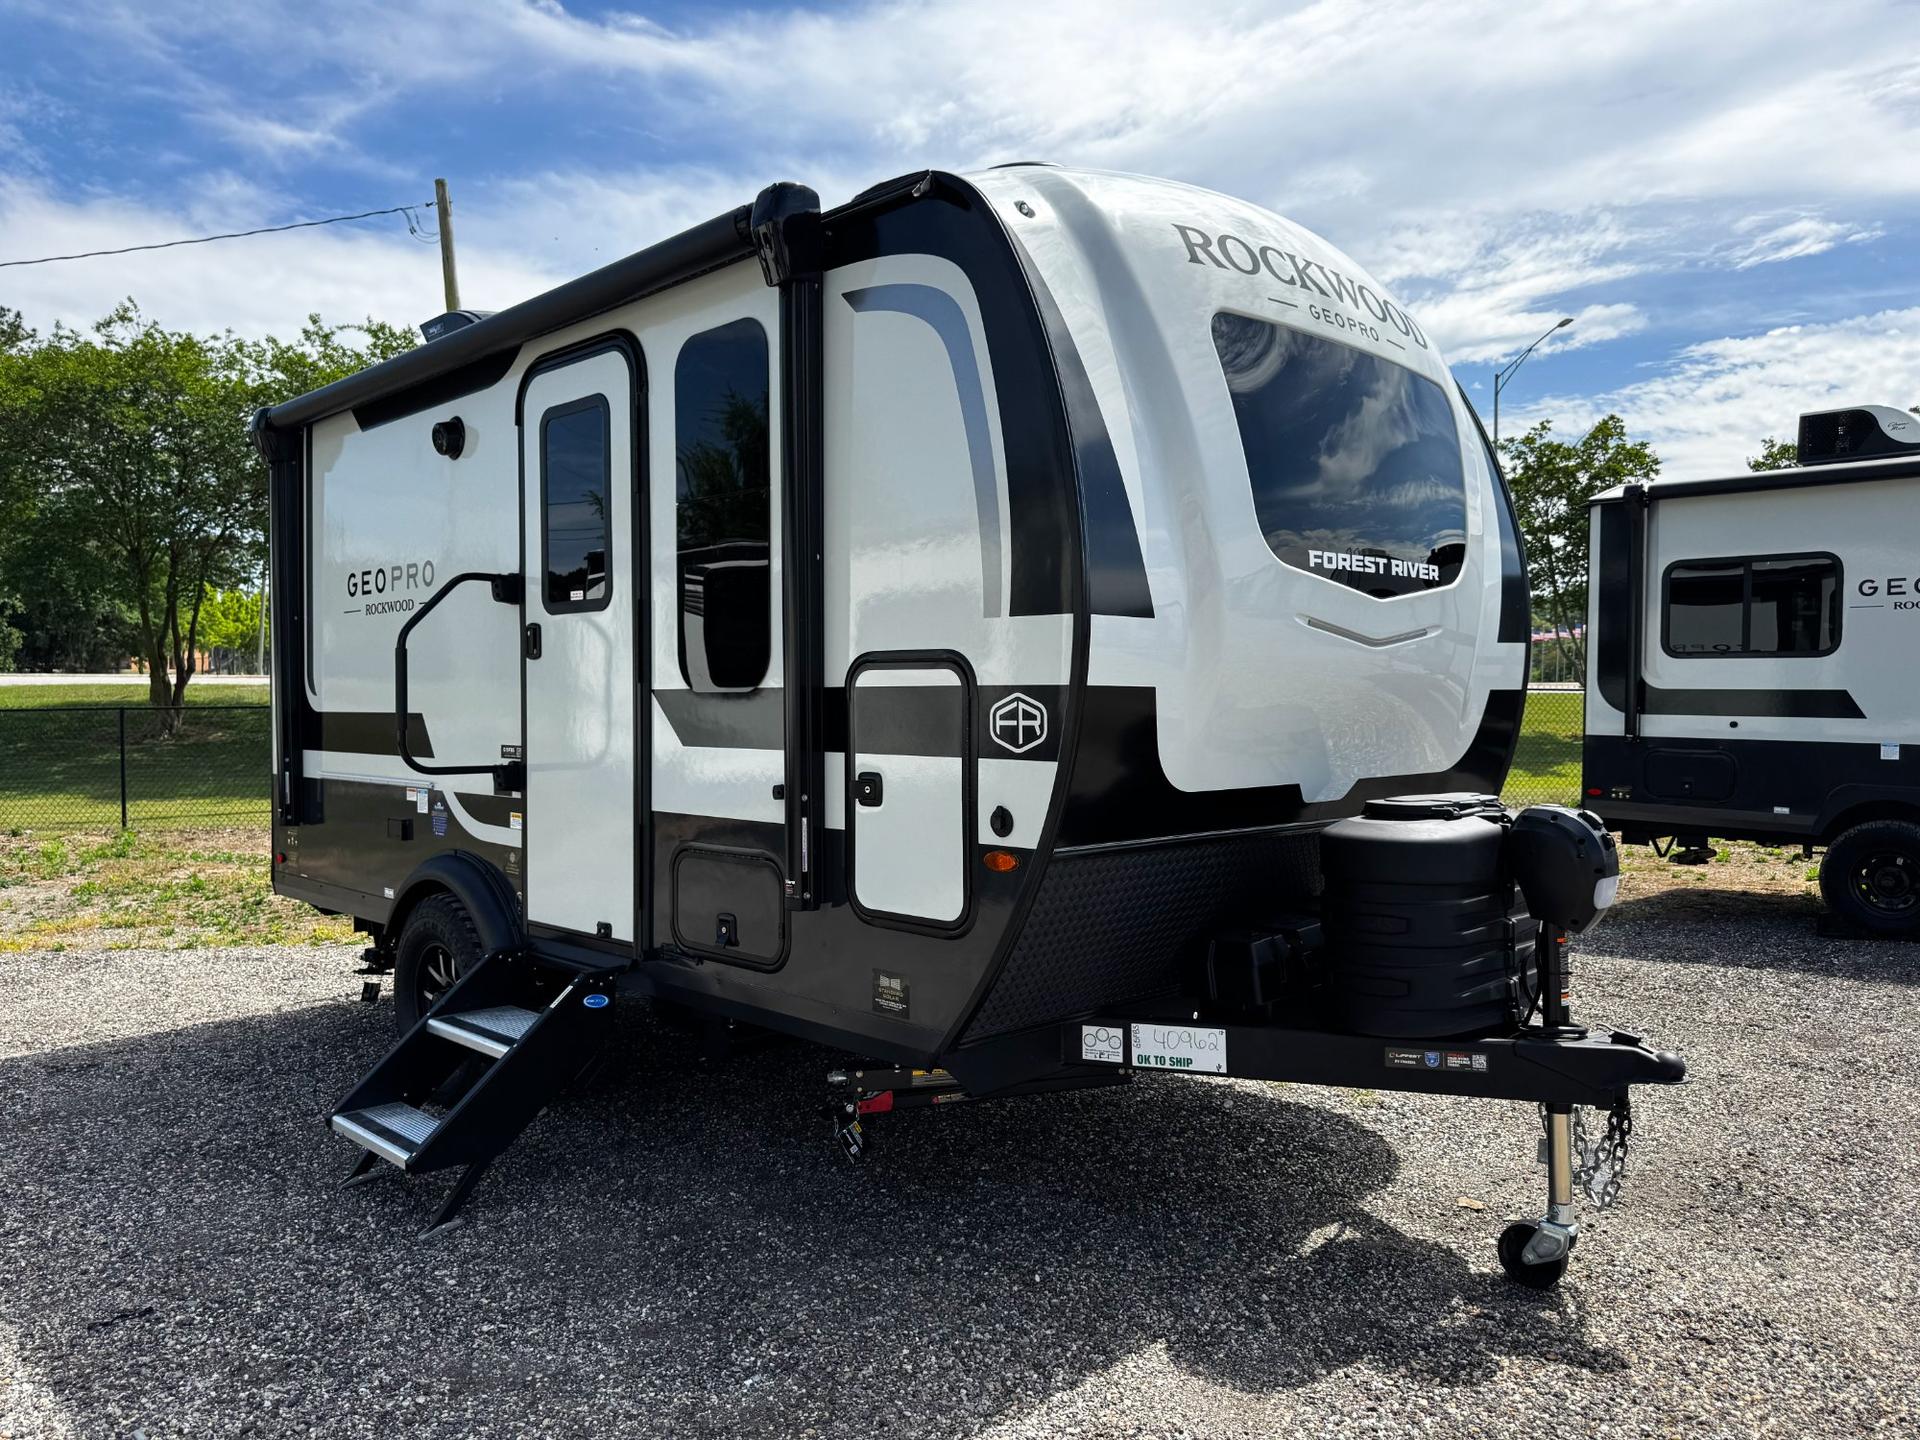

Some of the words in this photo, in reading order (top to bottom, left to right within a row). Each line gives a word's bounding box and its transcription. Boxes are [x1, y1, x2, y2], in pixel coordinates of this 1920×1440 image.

[1171, 222, 1428, 350] ROCKWOOD
[1308, 303, 1380, 343] GEOPRO
[347, 559, 435, 597] GEOPRO
[1307, 549, 1388, 575] FOREST
[1390, 559, 1440, 581] RIVER
[365, 598, 415, 616] ROCKWOOD
[1153, 1028, 1219, 1051] 40962
[1137, 1054, 1152, 1065] OK
[1153, 1055, 1166, 1067] TO
[1168, 1056, 1193, 1068] SHIP
